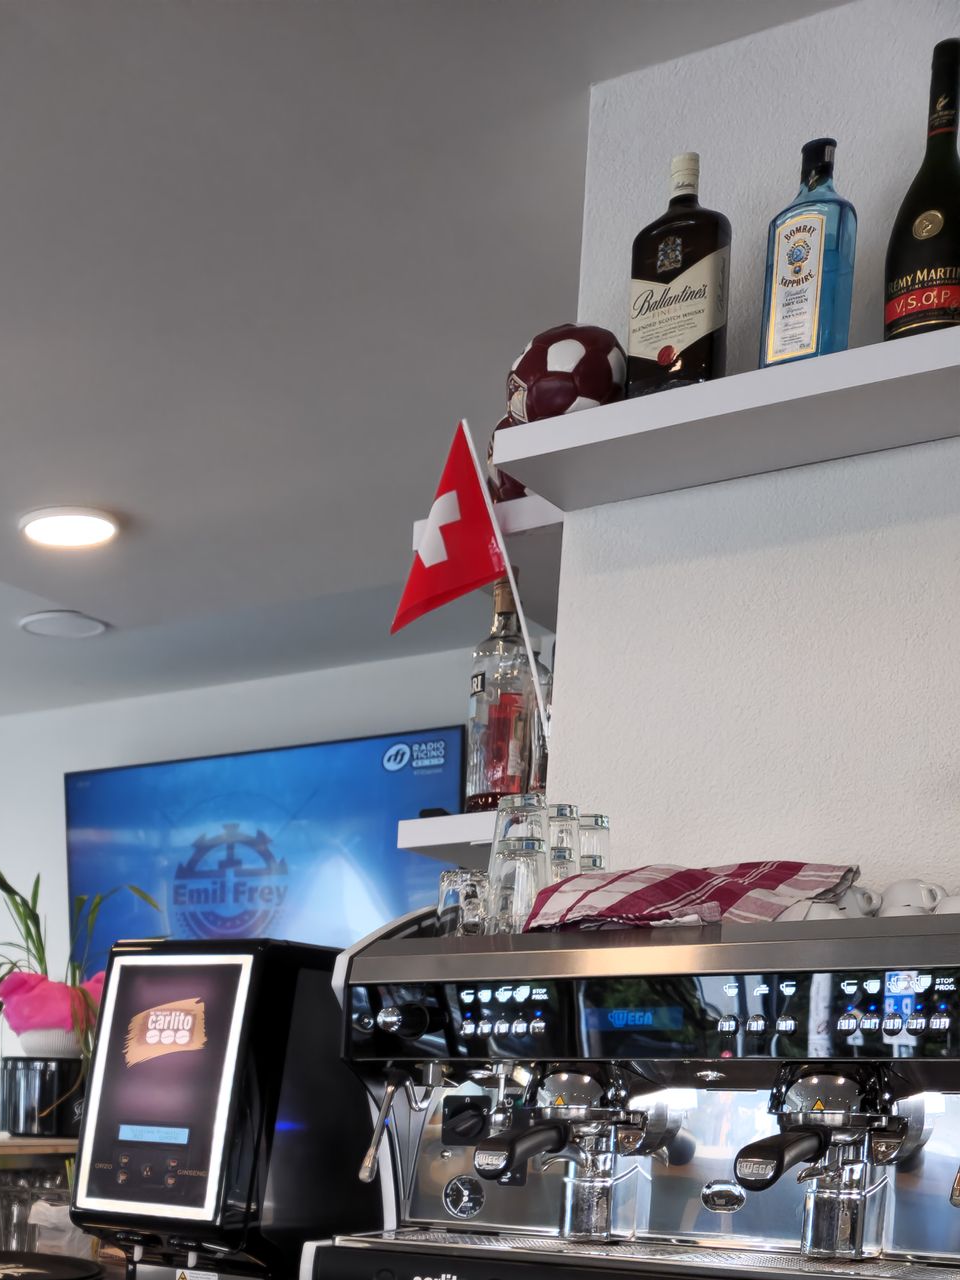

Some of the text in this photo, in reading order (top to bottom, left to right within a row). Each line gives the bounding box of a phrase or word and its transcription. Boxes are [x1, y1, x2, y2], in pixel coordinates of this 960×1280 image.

[412, 741, 445, 751] RADIO
[413, 749, 445, 760] TICINO
[173, 880, 289, 906] Emil Frey
[148, 1010, 192, 1030] carlito
[613, 1011, 653, 1026] WEGA
[741, 1162, 773, 1174] WEGA
